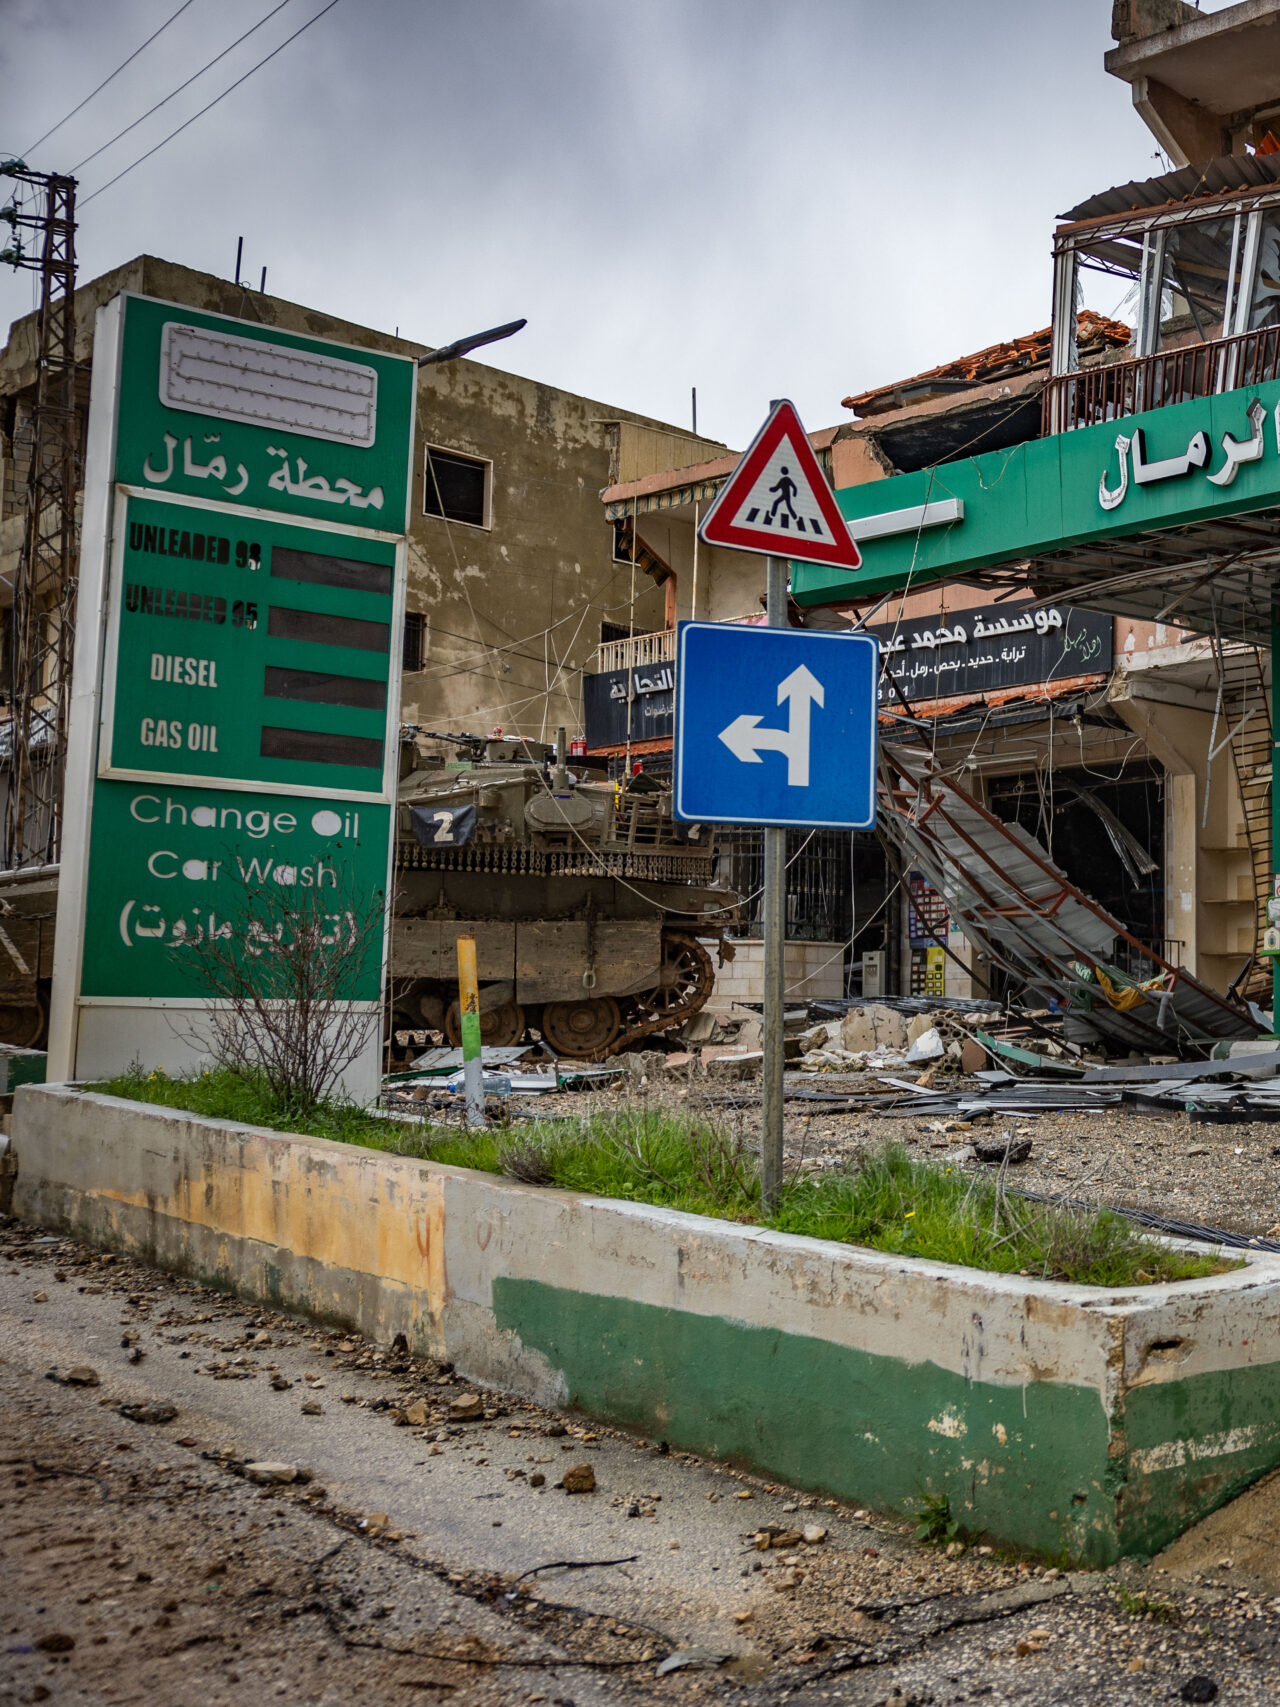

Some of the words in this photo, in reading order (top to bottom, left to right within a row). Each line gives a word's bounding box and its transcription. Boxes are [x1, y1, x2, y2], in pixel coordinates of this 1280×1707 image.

[265, 445, 385, 511] محطة
[129, 522, 231, 566] UNLEADED
[235, 540, 262, 571] 98
[126, 583, 227, 625] UNLEADED
[231, 600, 258, 630] 95
[911, 625, 967, 649] محمد
[1001, 646, 1027, 662] ترابة
[151, 653, 218, 688] DIESEL
[911, 661, 928, 678] رمل
[934, 660, 960, 675] بحص
[967, 655, 994, 669] حديد
[610, 668, 674, 704] التجارية
[140, 718, 182, 749] GAS
[187, 723, 218, 752] OIL
[130, 795, 297, 838] Change
[311, 810, 359, 838] Oil
[433, 811, 454, 843] 2
[148, 850, 223, 881] Car
[236, 854, 337, 889] Wash
